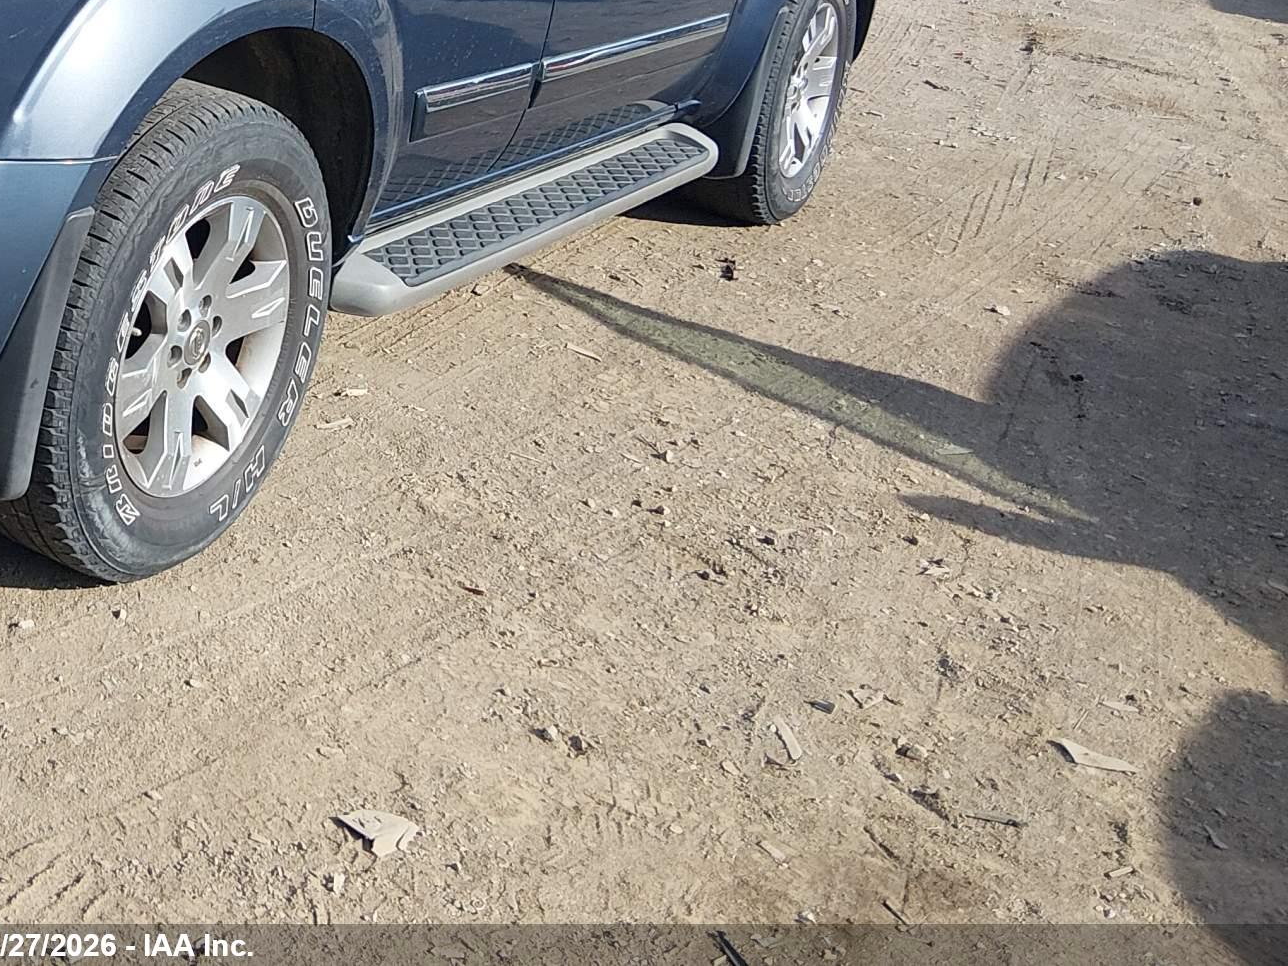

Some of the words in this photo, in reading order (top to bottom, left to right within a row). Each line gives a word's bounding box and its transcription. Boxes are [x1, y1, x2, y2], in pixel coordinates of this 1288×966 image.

[104, 164, 240, 526] BRIDGESTONE
[278, 197, 324, 427] DUELER
[209, 445, 265, 522] H/L
